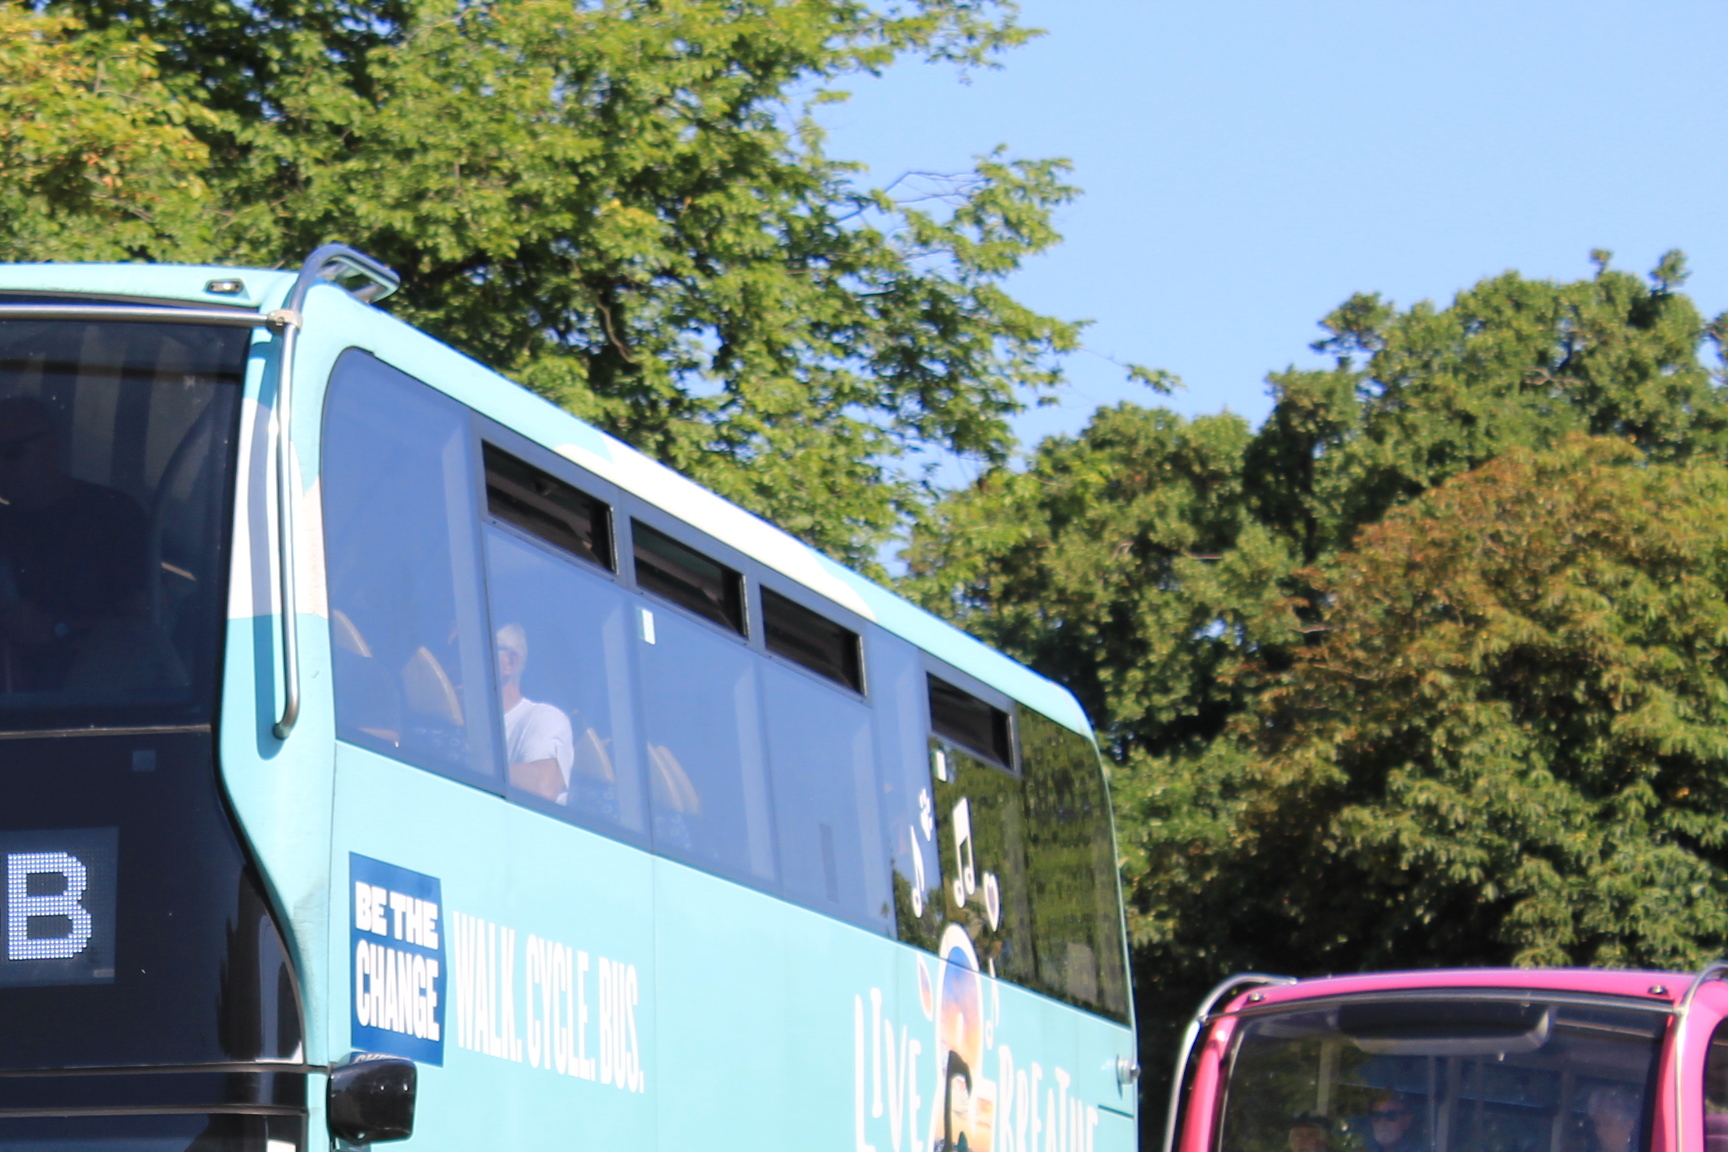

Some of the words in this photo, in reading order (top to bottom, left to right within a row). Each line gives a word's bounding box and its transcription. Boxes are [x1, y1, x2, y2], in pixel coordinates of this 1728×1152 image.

[355, 880, 388, 937] BE
[389, 890, 440, 951] THE
[355, 938, 441, 1042] CHANGE
[452, 910, 523, 1064] WALK.
[525, 933, 596, 1082] CYCLE.
[598, 955, 645, 1094] BUS.
